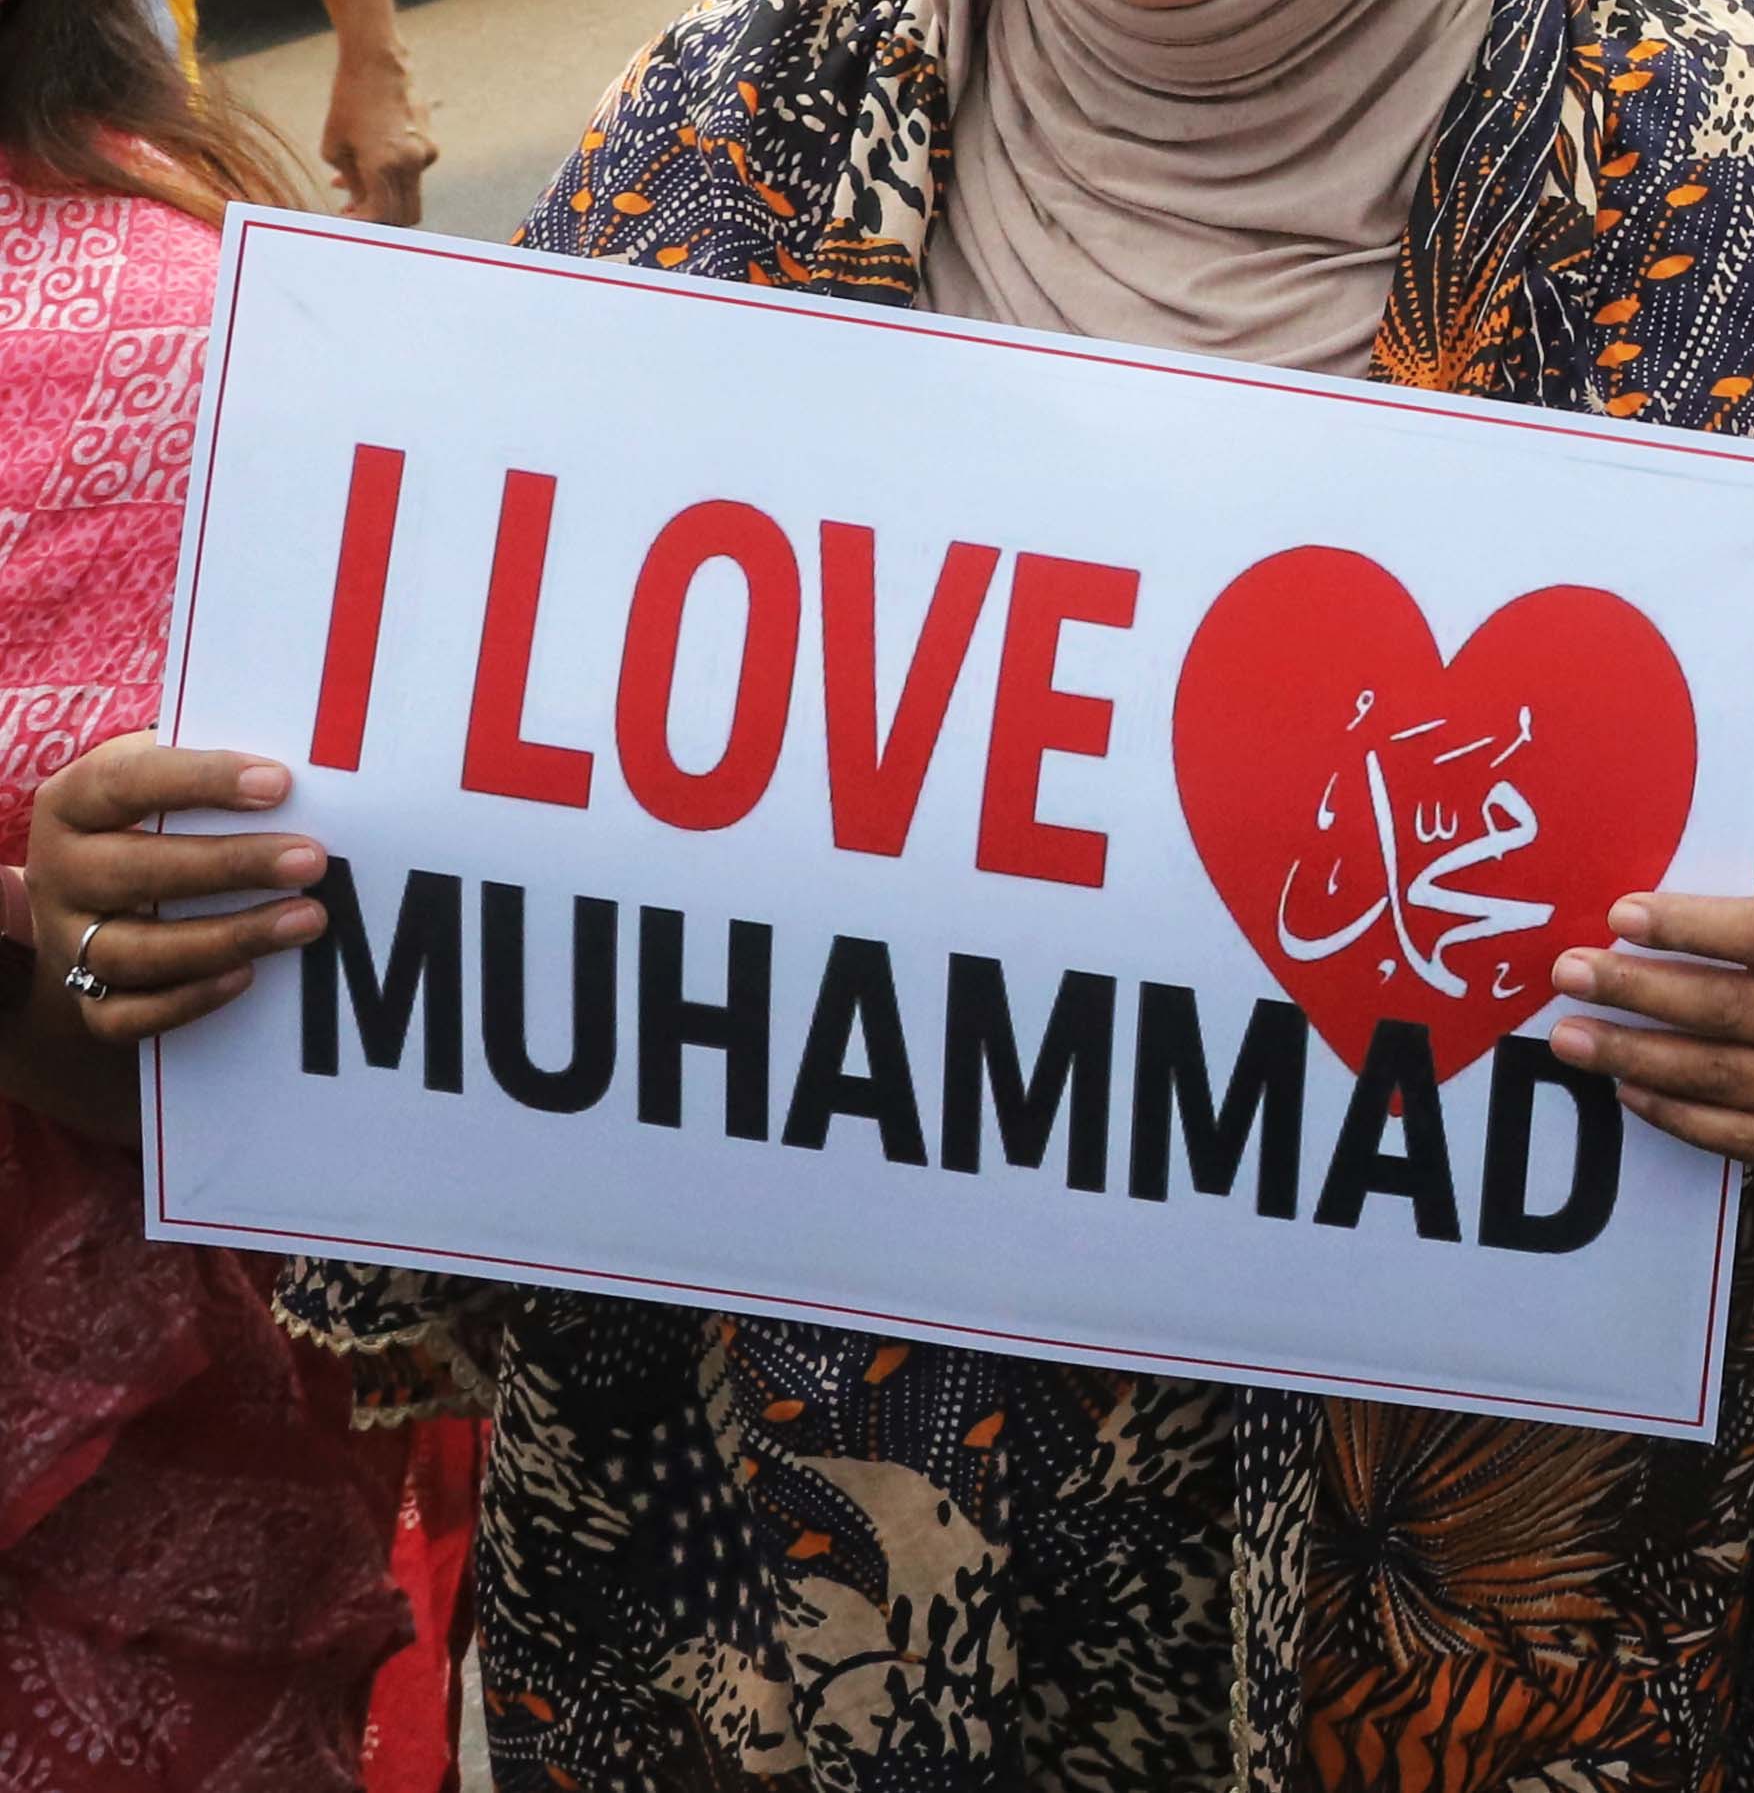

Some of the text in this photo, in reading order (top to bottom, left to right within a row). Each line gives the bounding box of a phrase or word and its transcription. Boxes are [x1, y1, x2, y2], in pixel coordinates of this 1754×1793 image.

[308, 443, 1140, 889] I LOVE
[300, 857, 1624, 1254] MUHAMMAD
